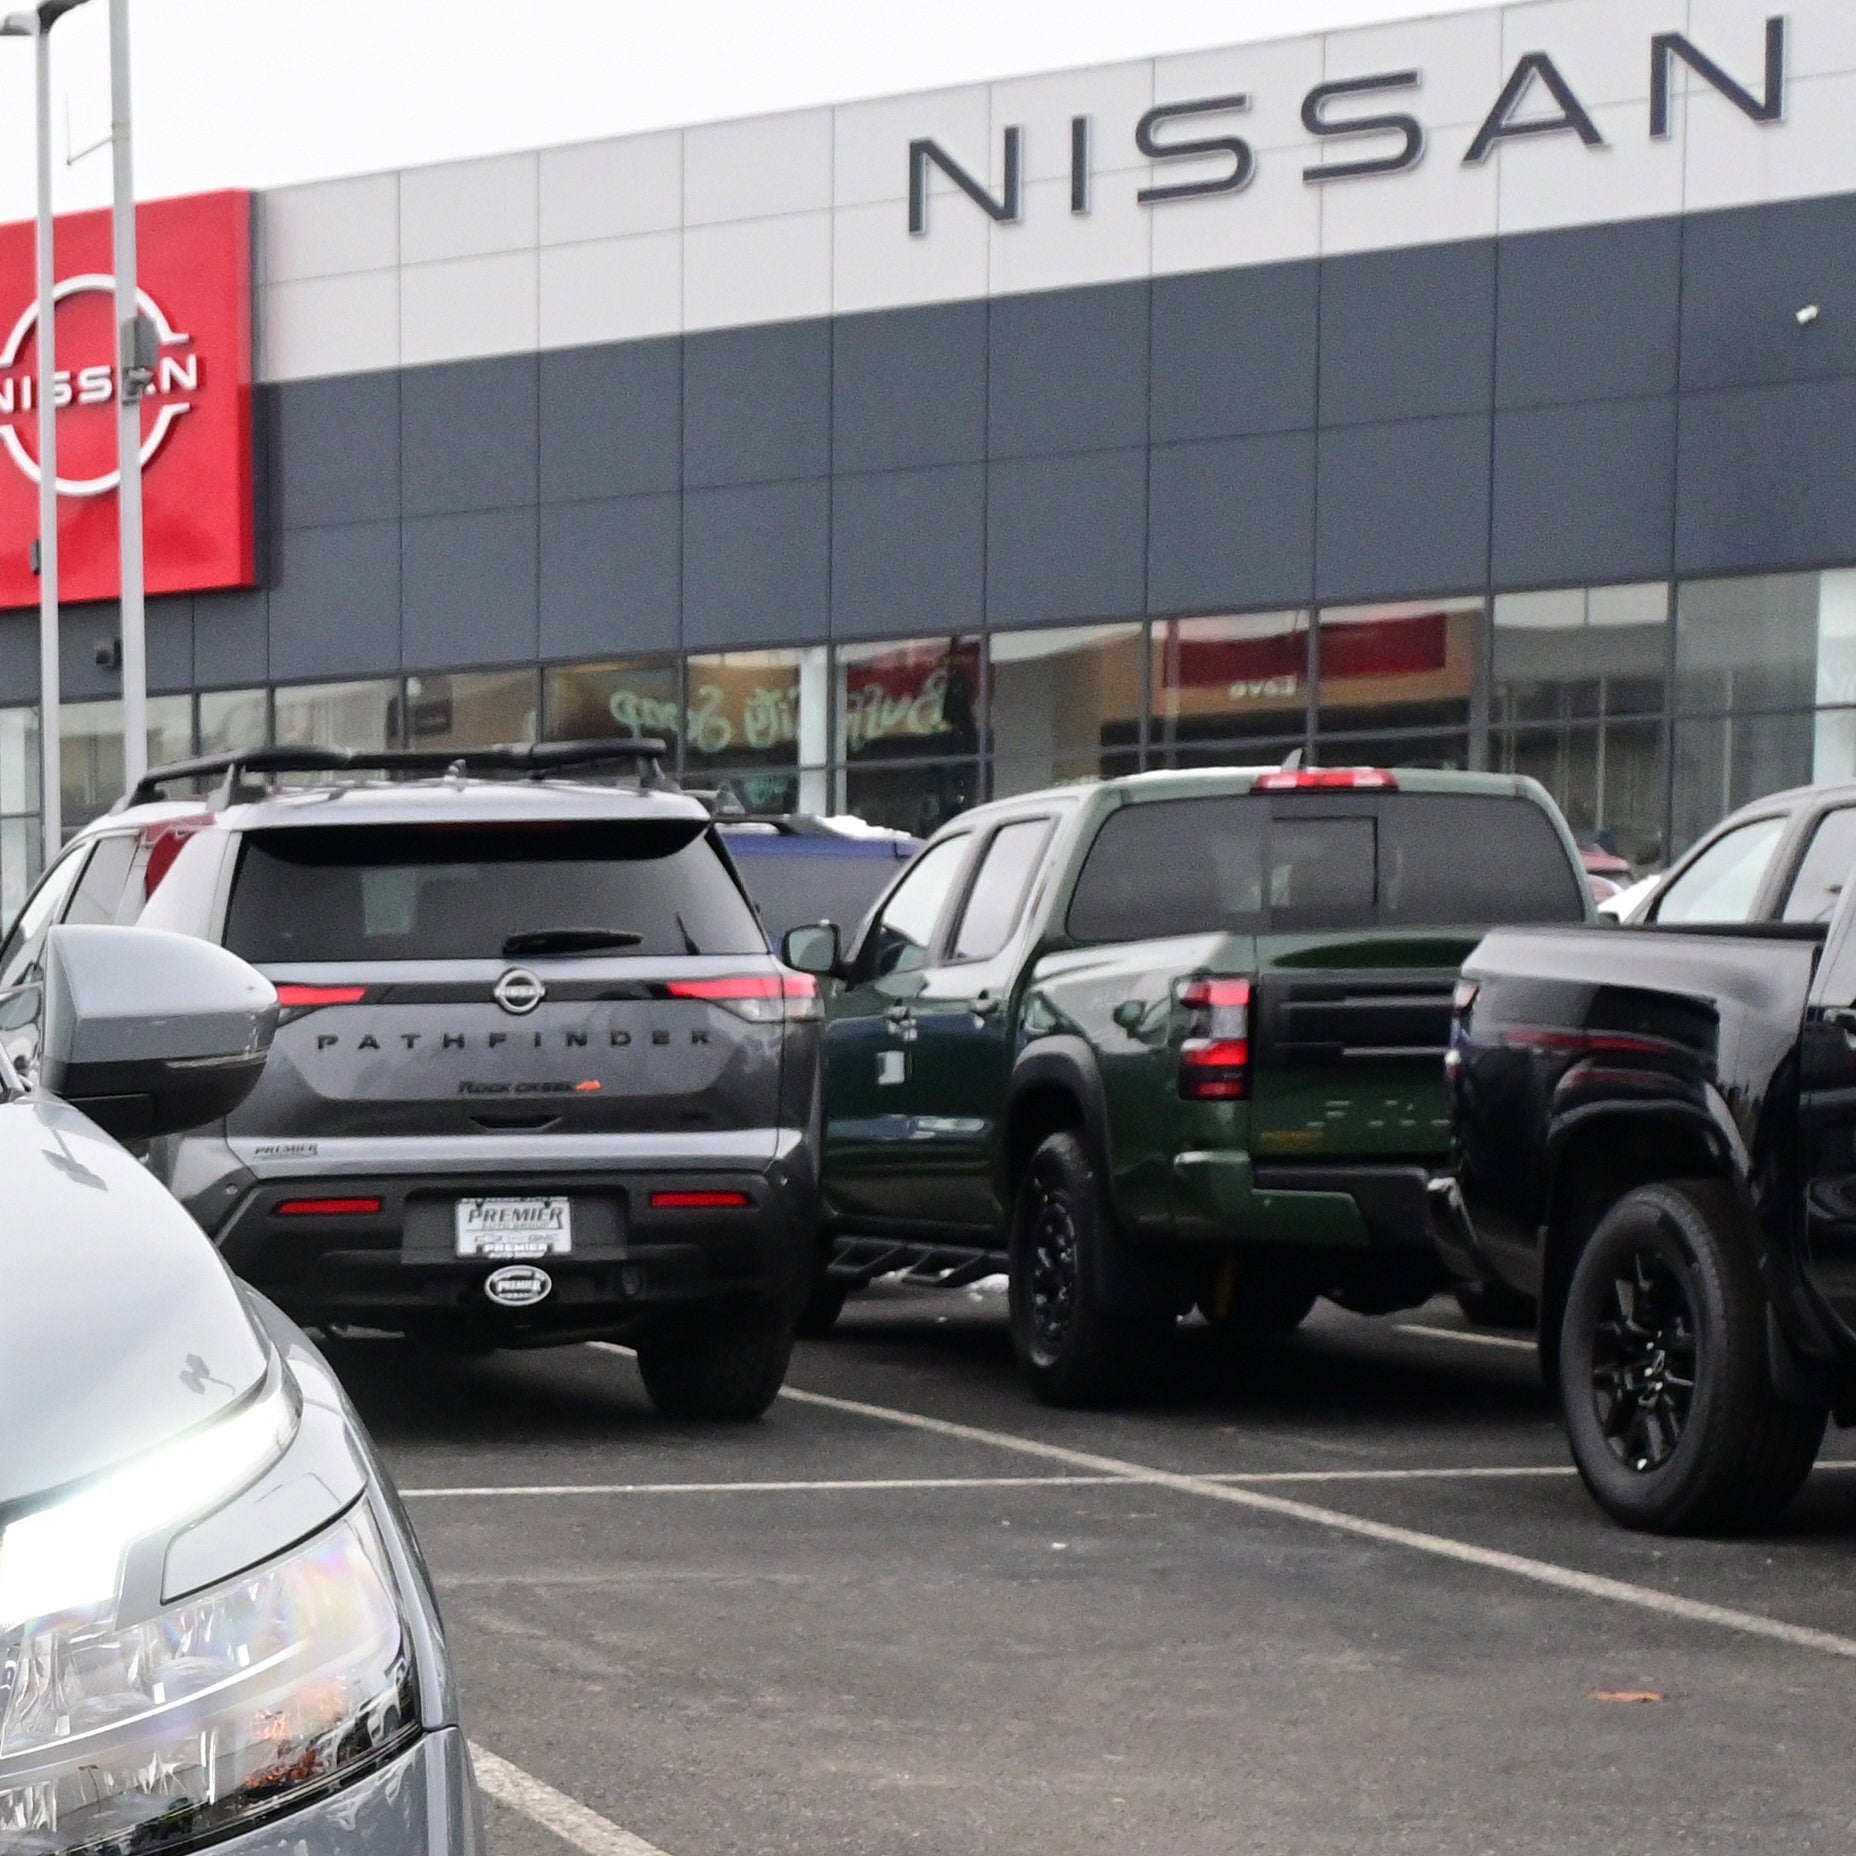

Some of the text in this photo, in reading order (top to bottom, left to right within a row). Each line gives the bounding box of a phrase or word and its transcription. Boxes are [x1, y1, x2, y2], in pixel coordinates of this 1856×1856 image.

[908, 15, 1788, 235] NISSAN
[317, 1030, 712, 1051] PATHFINDER
[468, 1207, 563, 1229] PREMIER
